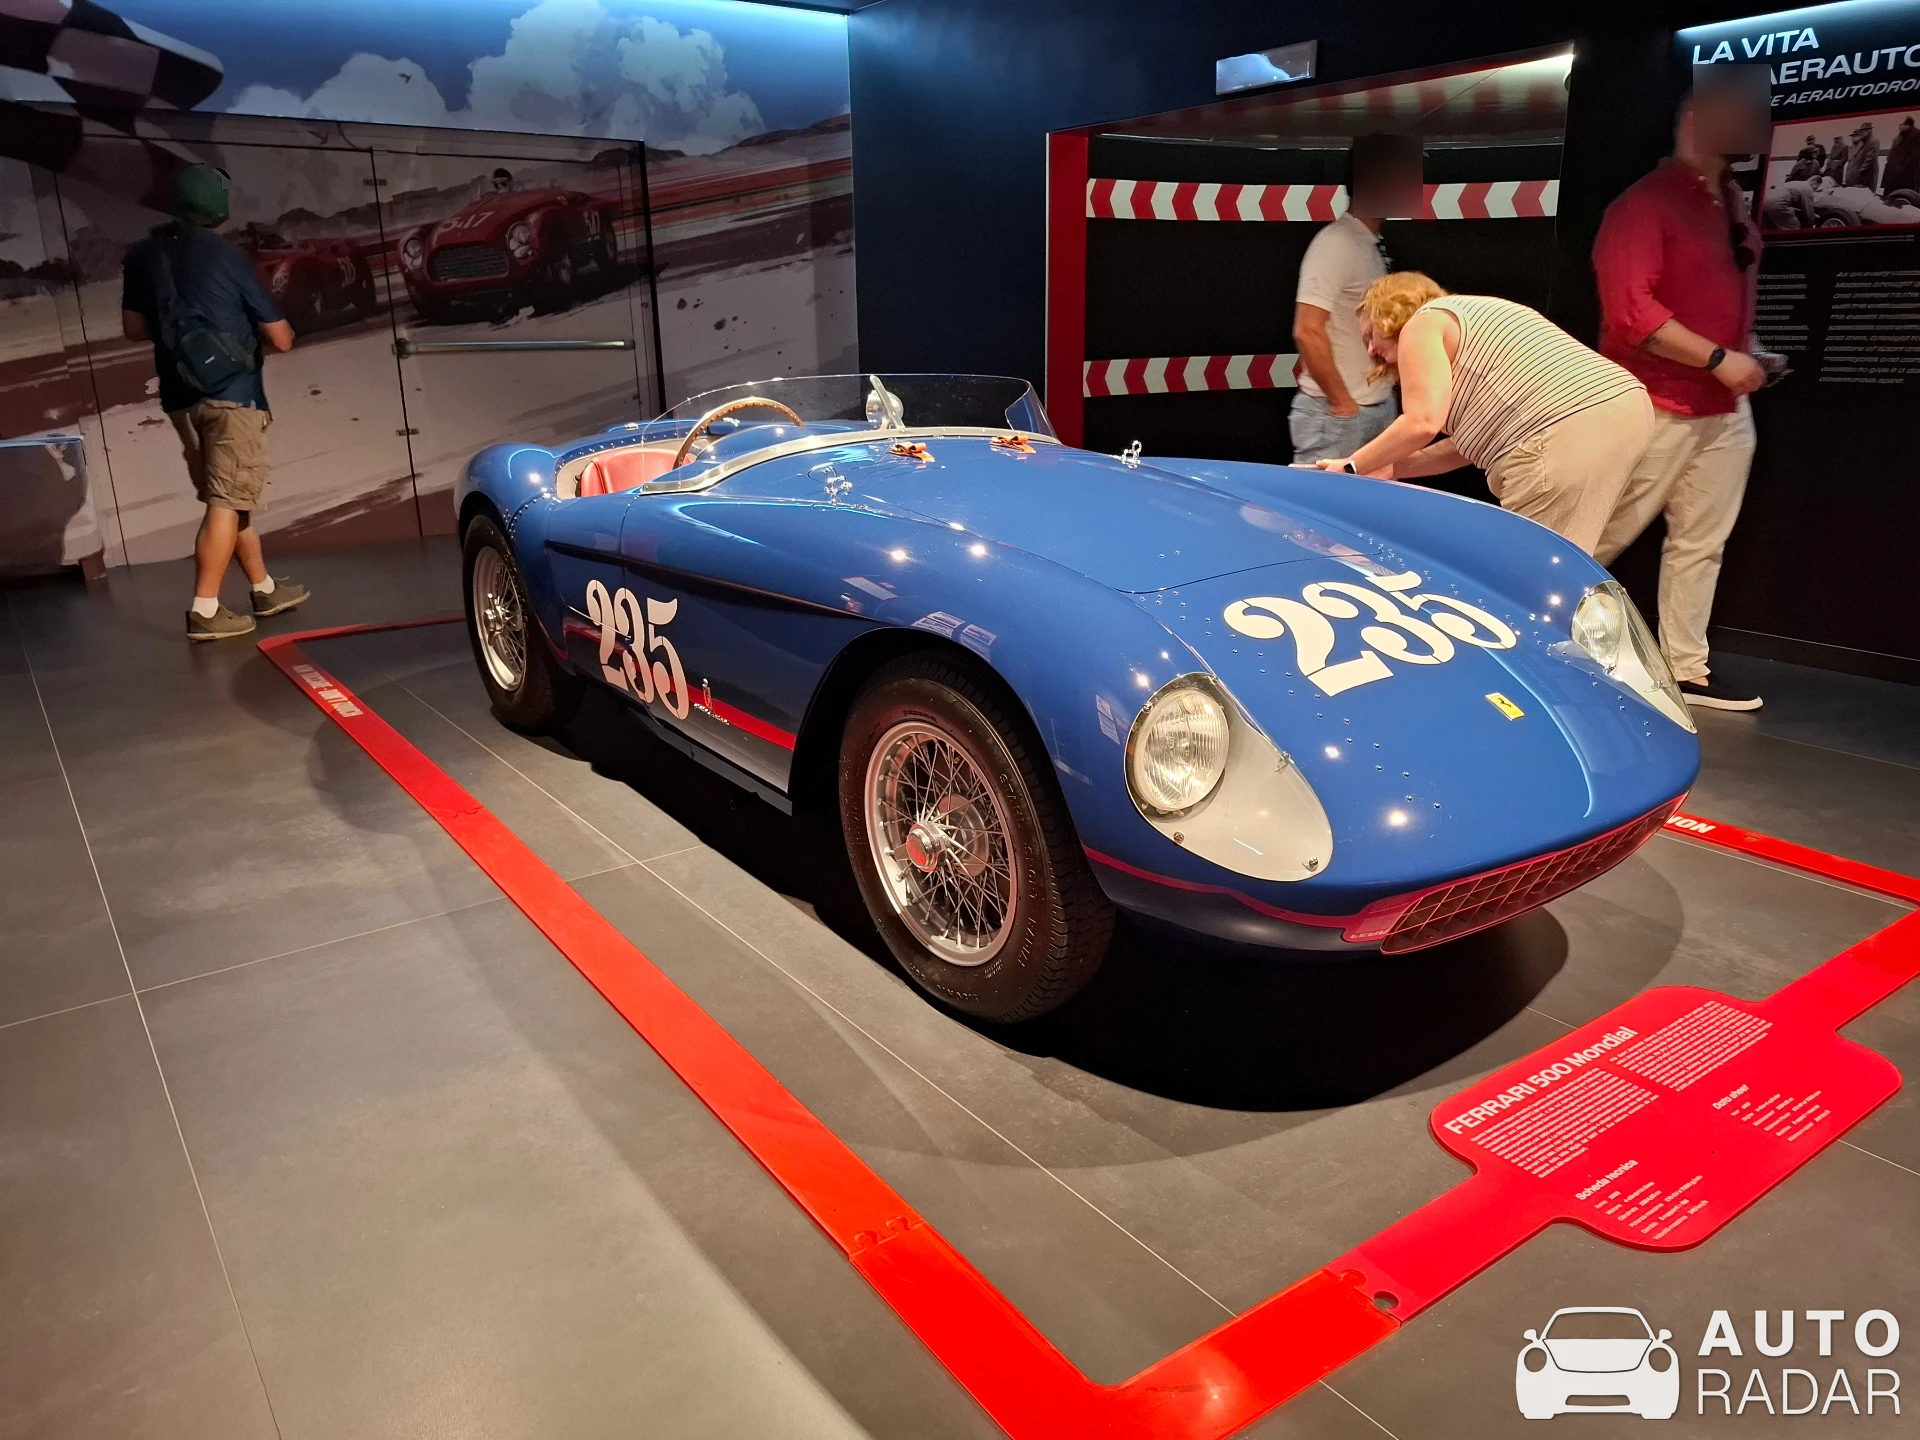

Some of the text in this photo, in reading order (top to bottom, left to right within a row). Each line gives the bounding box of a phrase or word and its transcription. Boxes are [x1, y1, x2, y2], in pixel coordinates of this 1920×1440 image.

[1692, 27, 1819, 65] LA VITA
[1783, 78, 1920, 106] AERAUTODRO
[585, 579, 690, 720] 235
[1223, 570, 1517, 697] 235
[1443, 1082, 1538, 1135] FERRARI
[1528, 1062, 1573, 1088] 500
[1563, 1025, 1639, 1067] Mondial
[1712, 1083, 1750, 1110] Data sheet
[1575, 1177, 1610, 1200] Scheda
[1605, 1159, 1638, 1181] tecnica
